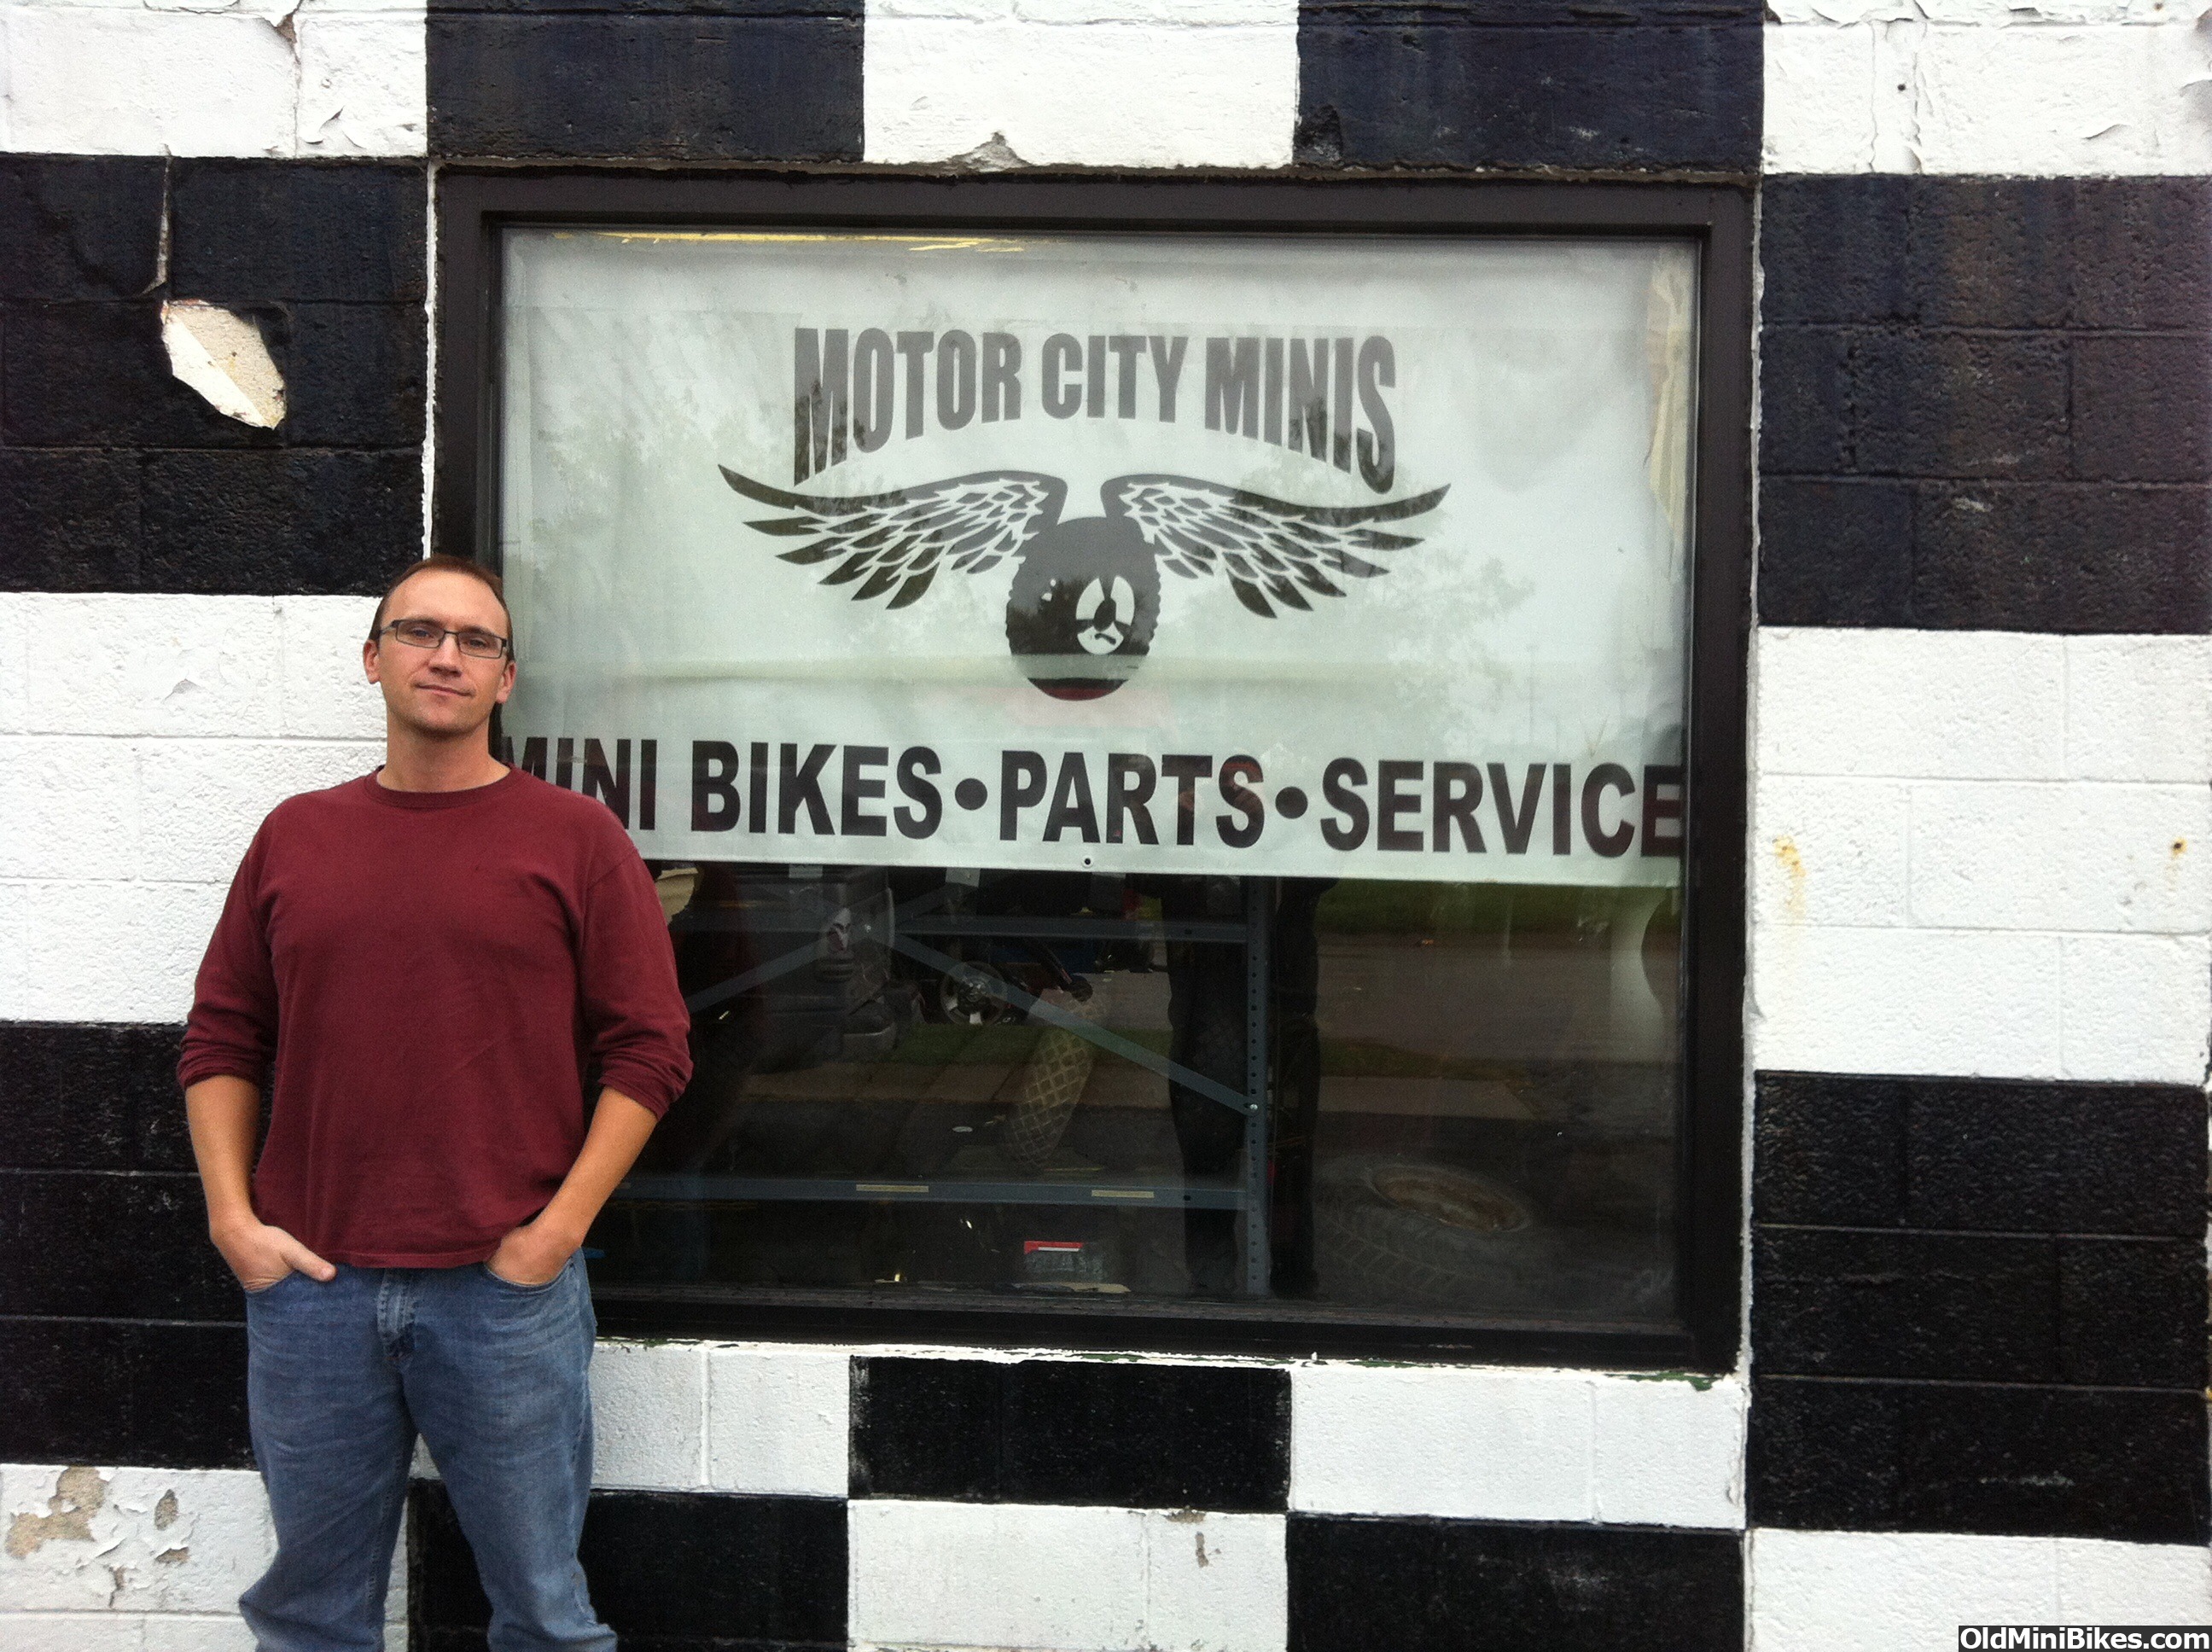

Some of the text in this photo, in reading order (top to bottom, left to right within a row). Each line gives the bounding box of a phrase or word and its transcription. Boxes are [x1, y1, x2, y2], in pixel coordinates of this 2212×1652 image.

[794, 327, 1397, 495] MOTOR CITY MINIS
[690, 739, 944, 840] BIKES
[998, 750, 1266, 849] PARTS
[1319, 757, 1685, 858] SERVICE
